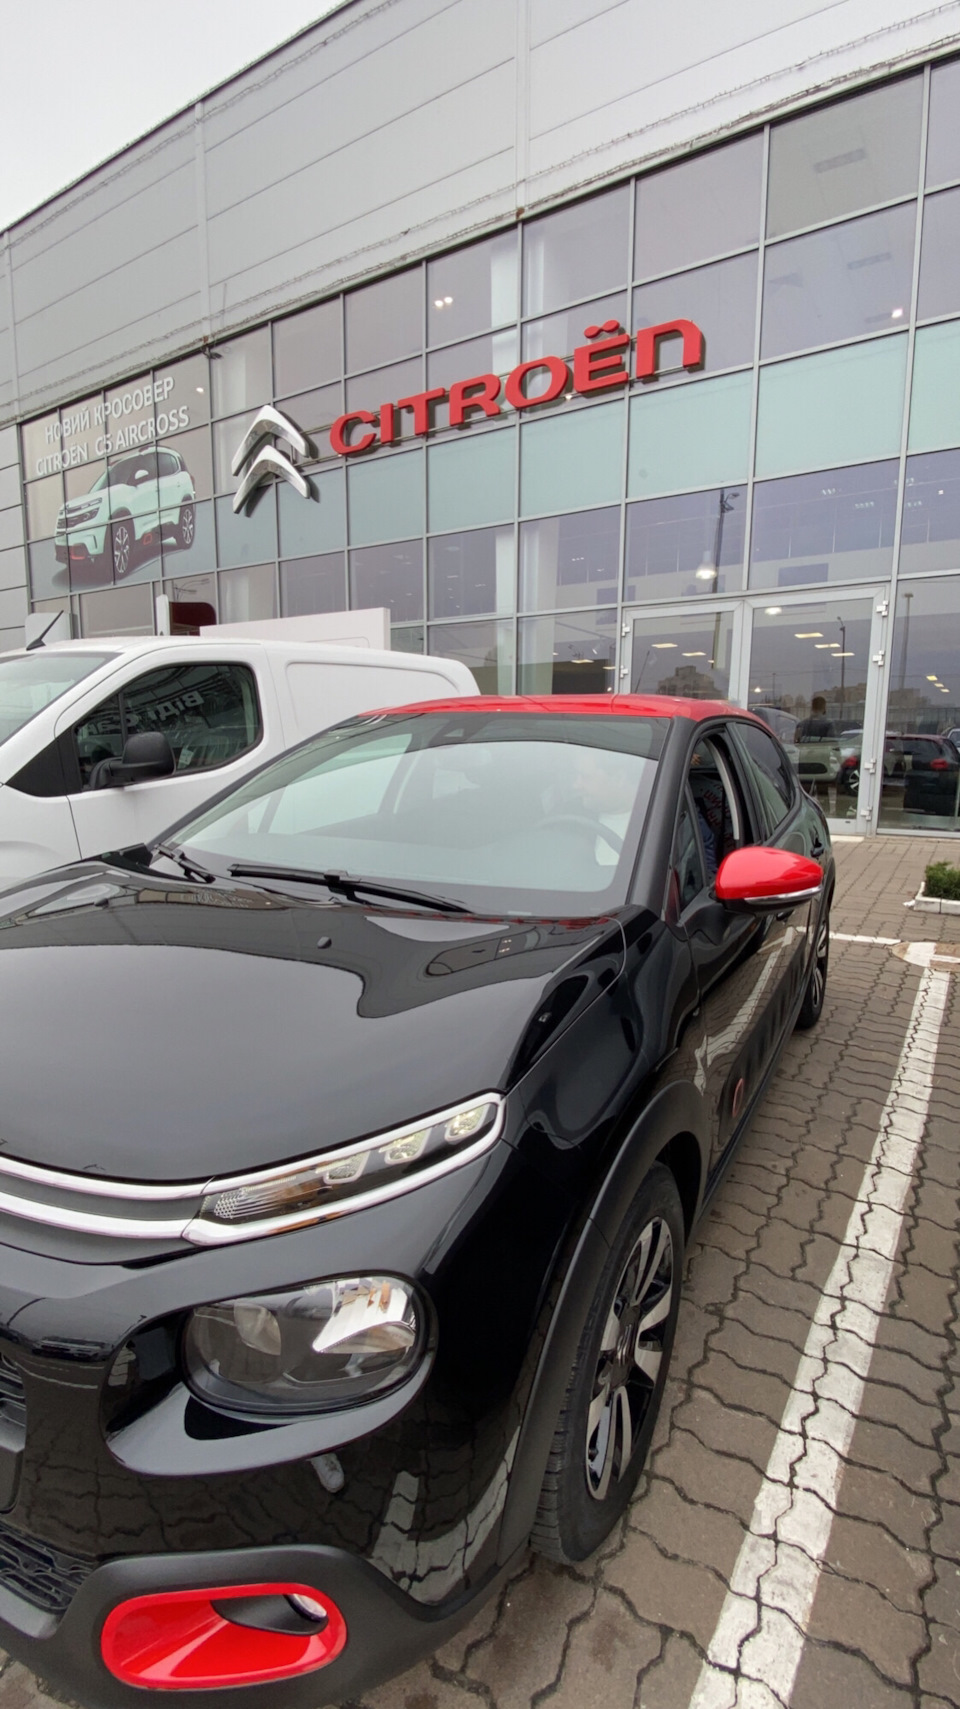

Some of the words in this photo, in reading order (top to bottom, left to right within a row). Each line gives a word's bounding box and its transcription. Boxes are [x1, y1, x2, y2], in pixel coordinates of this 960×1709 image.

[36, 443, 89, 476] CITROËN
[95, 434, 112, 457] C5
[116, 405, 189, 450] AIRCROSS
[44, 408, 91, 444] НОВИЙ
[94, 377, 174, 425] КРОСОВЕР
